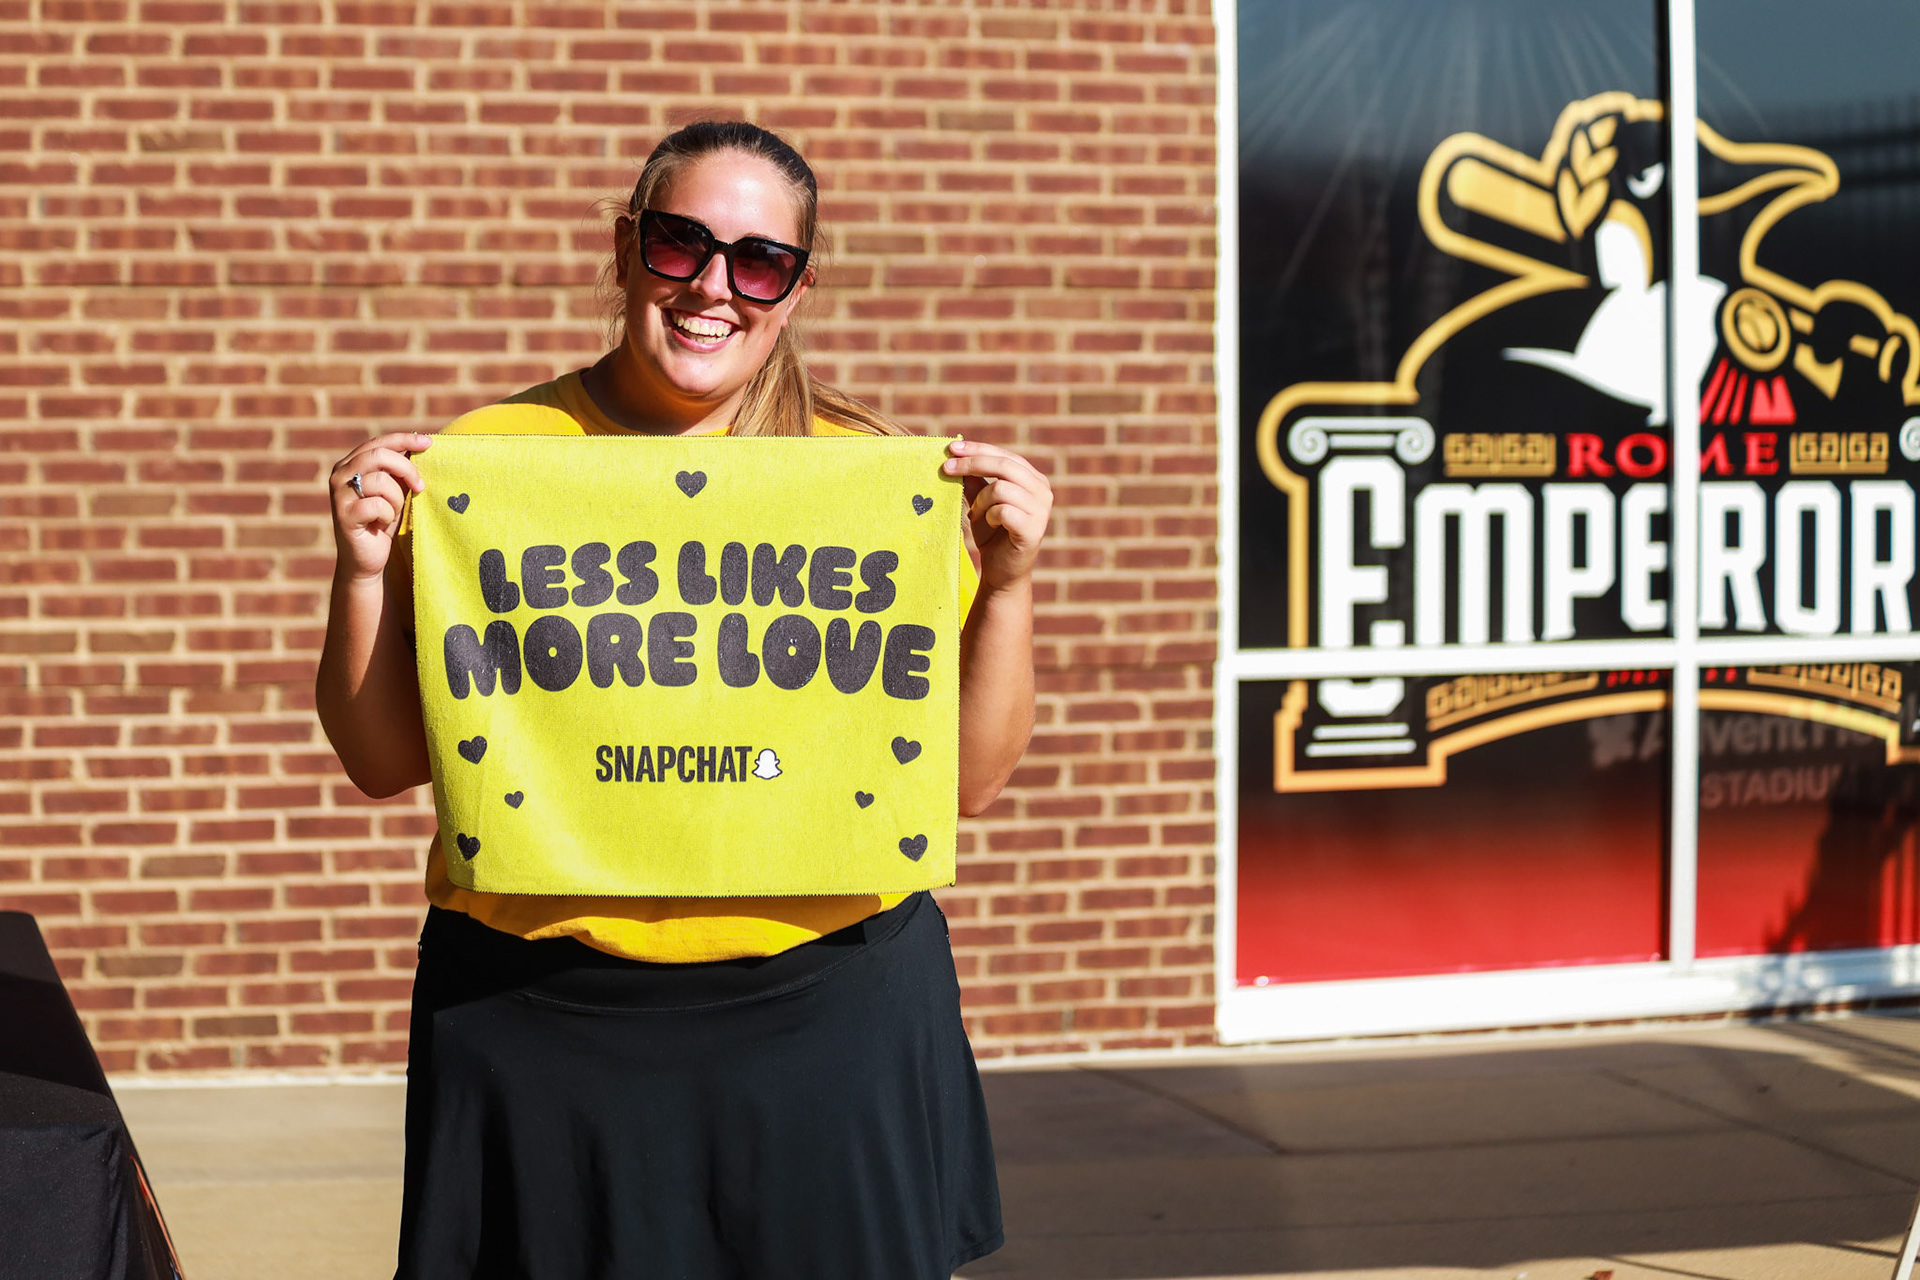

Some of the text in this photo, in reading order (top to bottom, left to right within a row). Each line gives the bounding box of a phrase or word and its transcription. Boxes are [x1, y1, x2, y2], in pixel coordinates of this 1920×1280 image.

[478, 540, 899, 613] LESS LIKES
[443, 611, 937, 701] MORE LOVE
[595, 744, 753, 783] SNAPCHAT
[1699, 763, 1842, 809] STADIU
